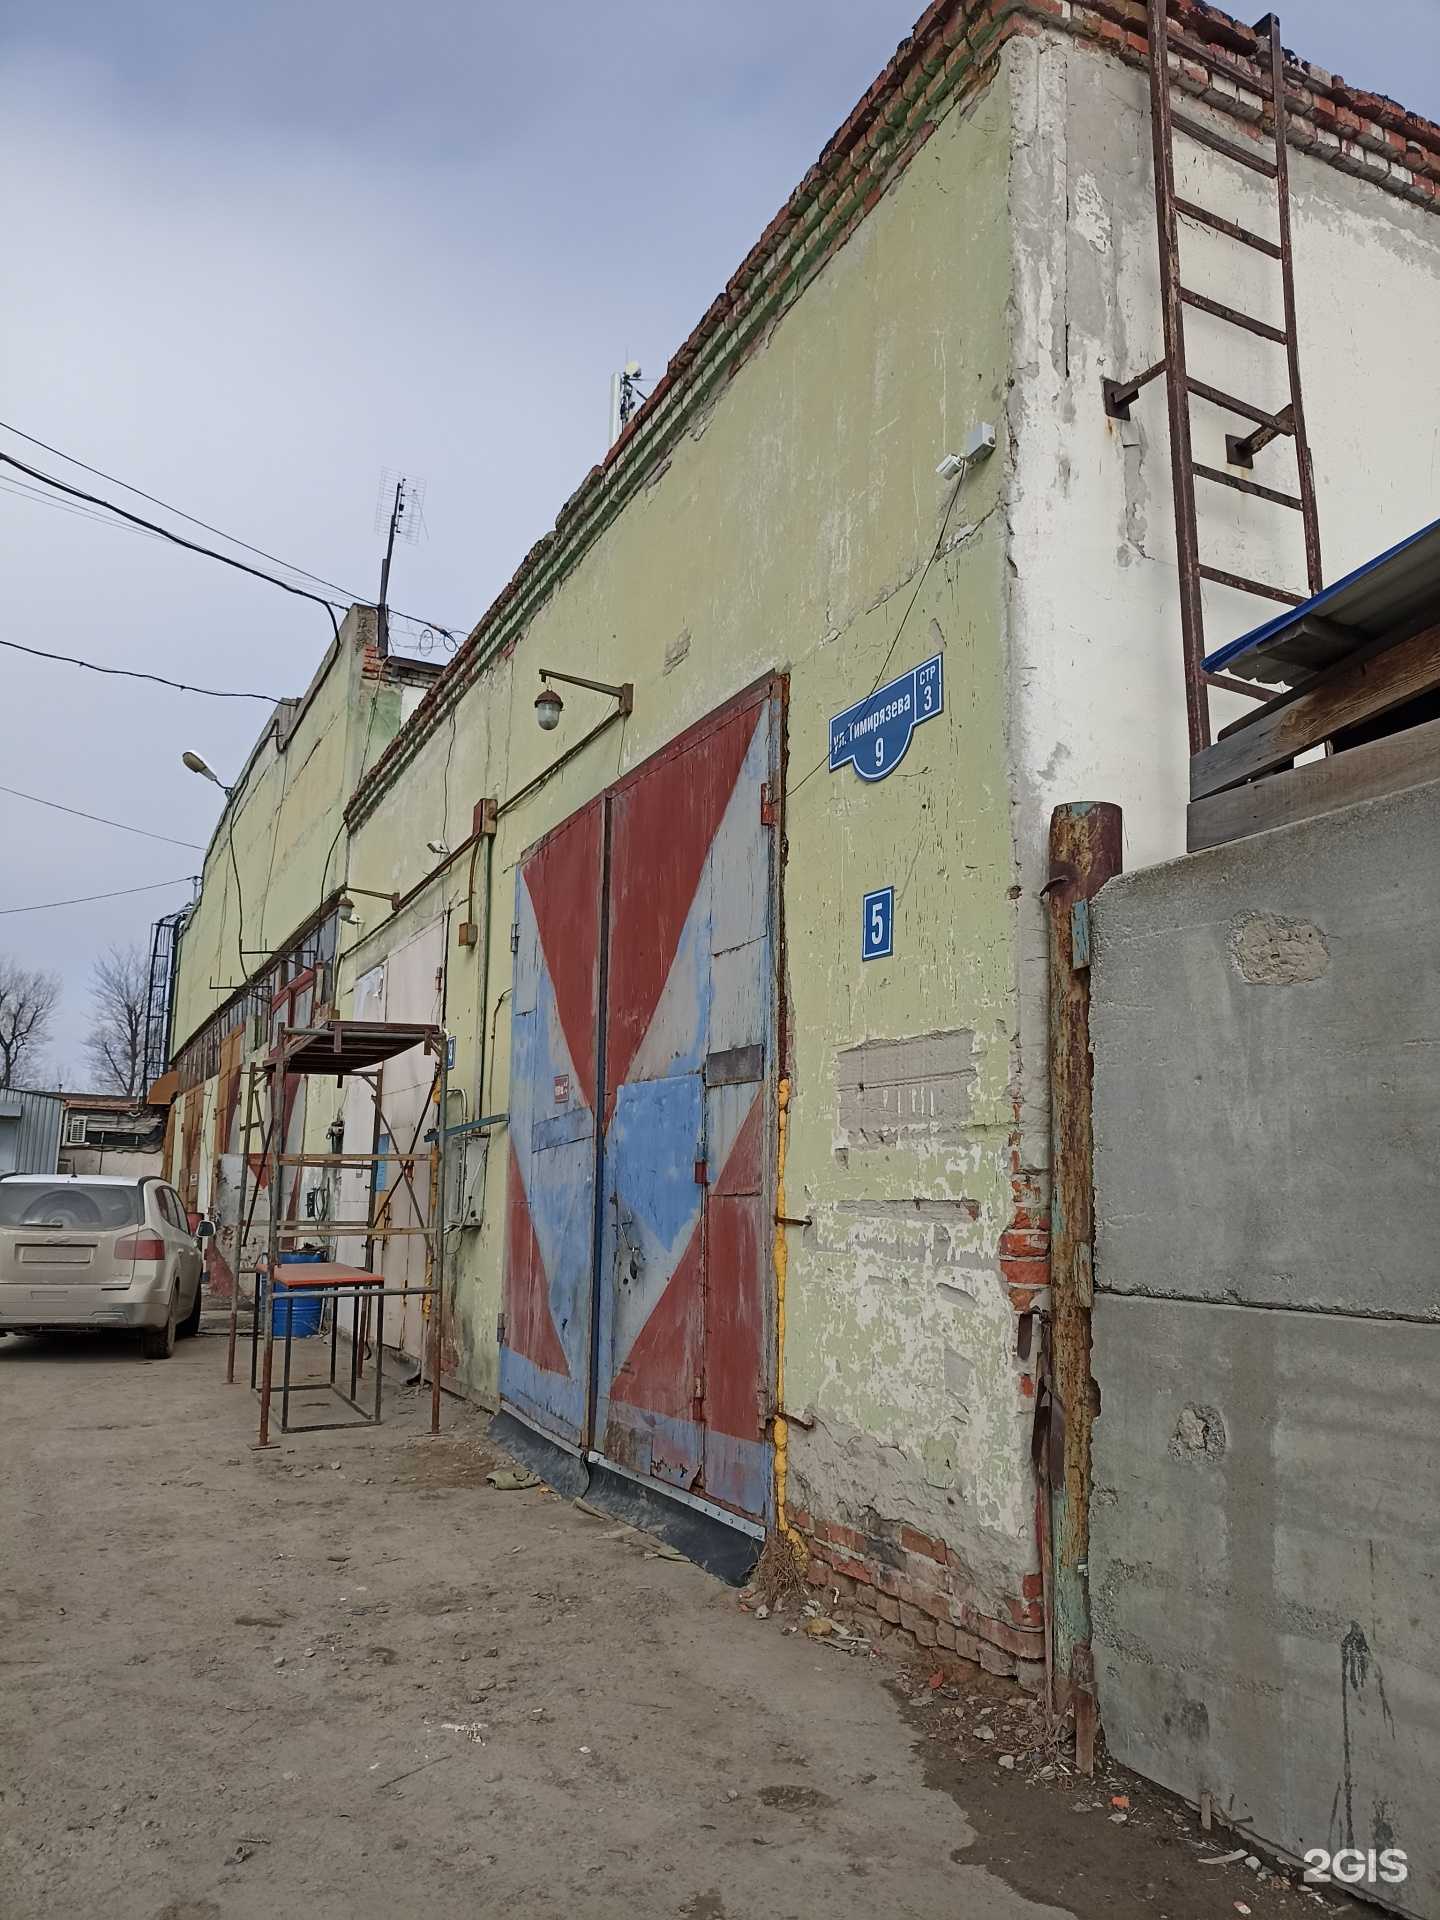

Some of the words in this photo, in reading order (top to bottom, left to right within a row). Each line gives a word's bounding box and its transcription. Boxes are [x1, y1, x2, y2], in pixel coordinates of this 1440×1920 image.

[924, 685, 932, 711] 3
[833, 731, 847, 754] ул.
[848, 694, 911, 741] Тимирязева
[875, 738, 884, 767] 9
[871, 902, 883, 945] 5
